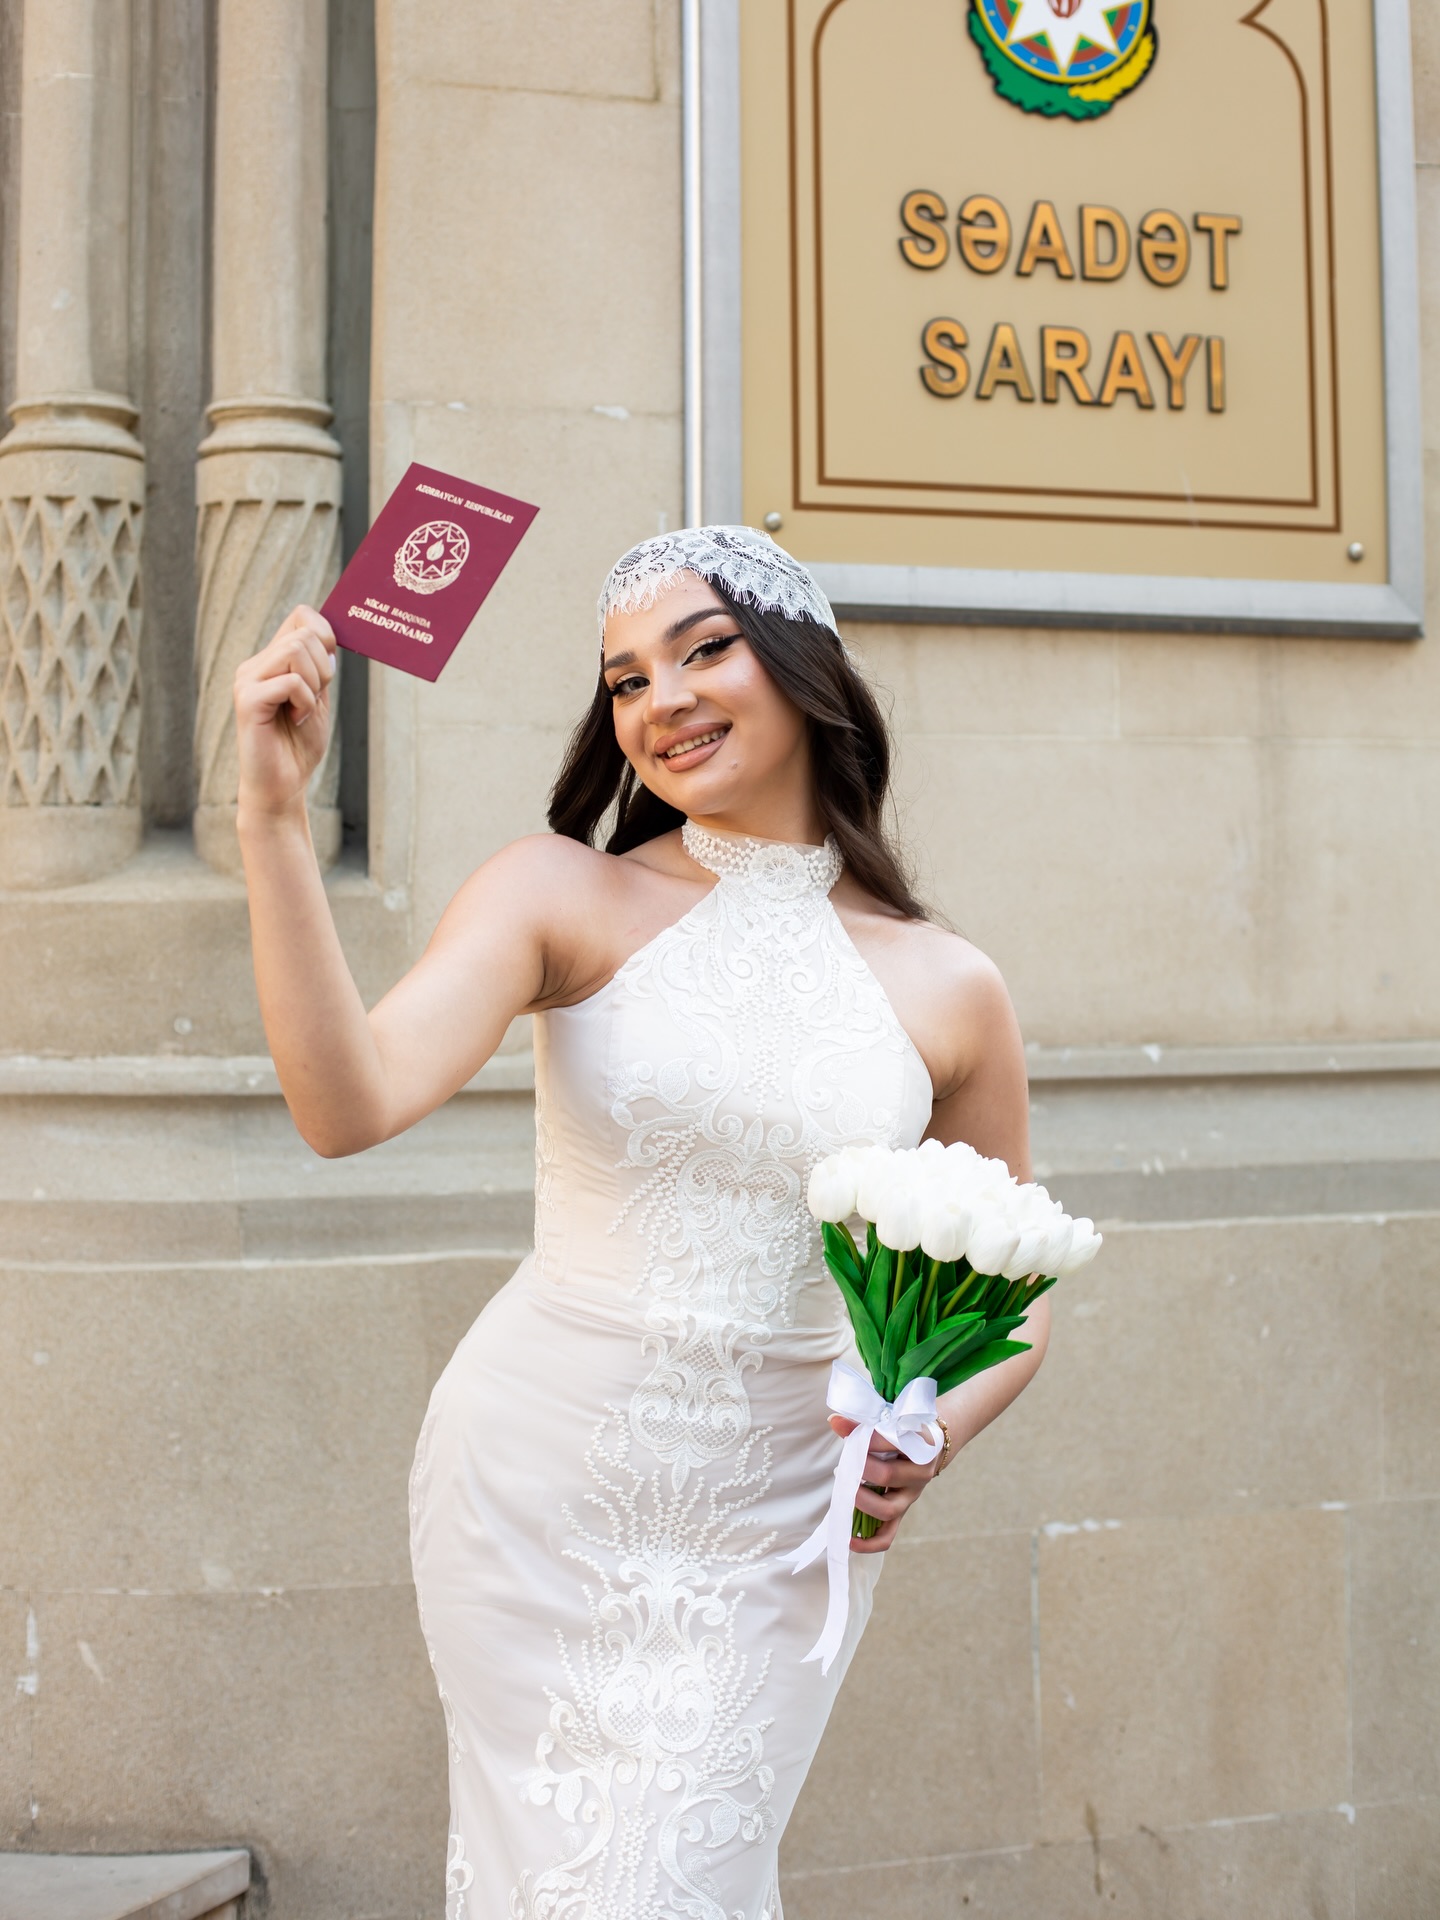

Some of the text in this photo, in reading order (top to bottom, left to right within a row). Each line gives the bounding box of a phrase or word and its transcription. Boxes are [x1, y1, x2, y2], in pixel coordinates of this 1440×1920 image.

[899, 189, 1242, 291] SƏADƏT
[919, 316, 1225, 413] SARAYI
[415, 484, 464, 506] AZƏRBAYCAN
[347, 605, 434, 645] ŞƏHADƏTNAMƏ
[390, 606, 431, 629] HAQQINDA
